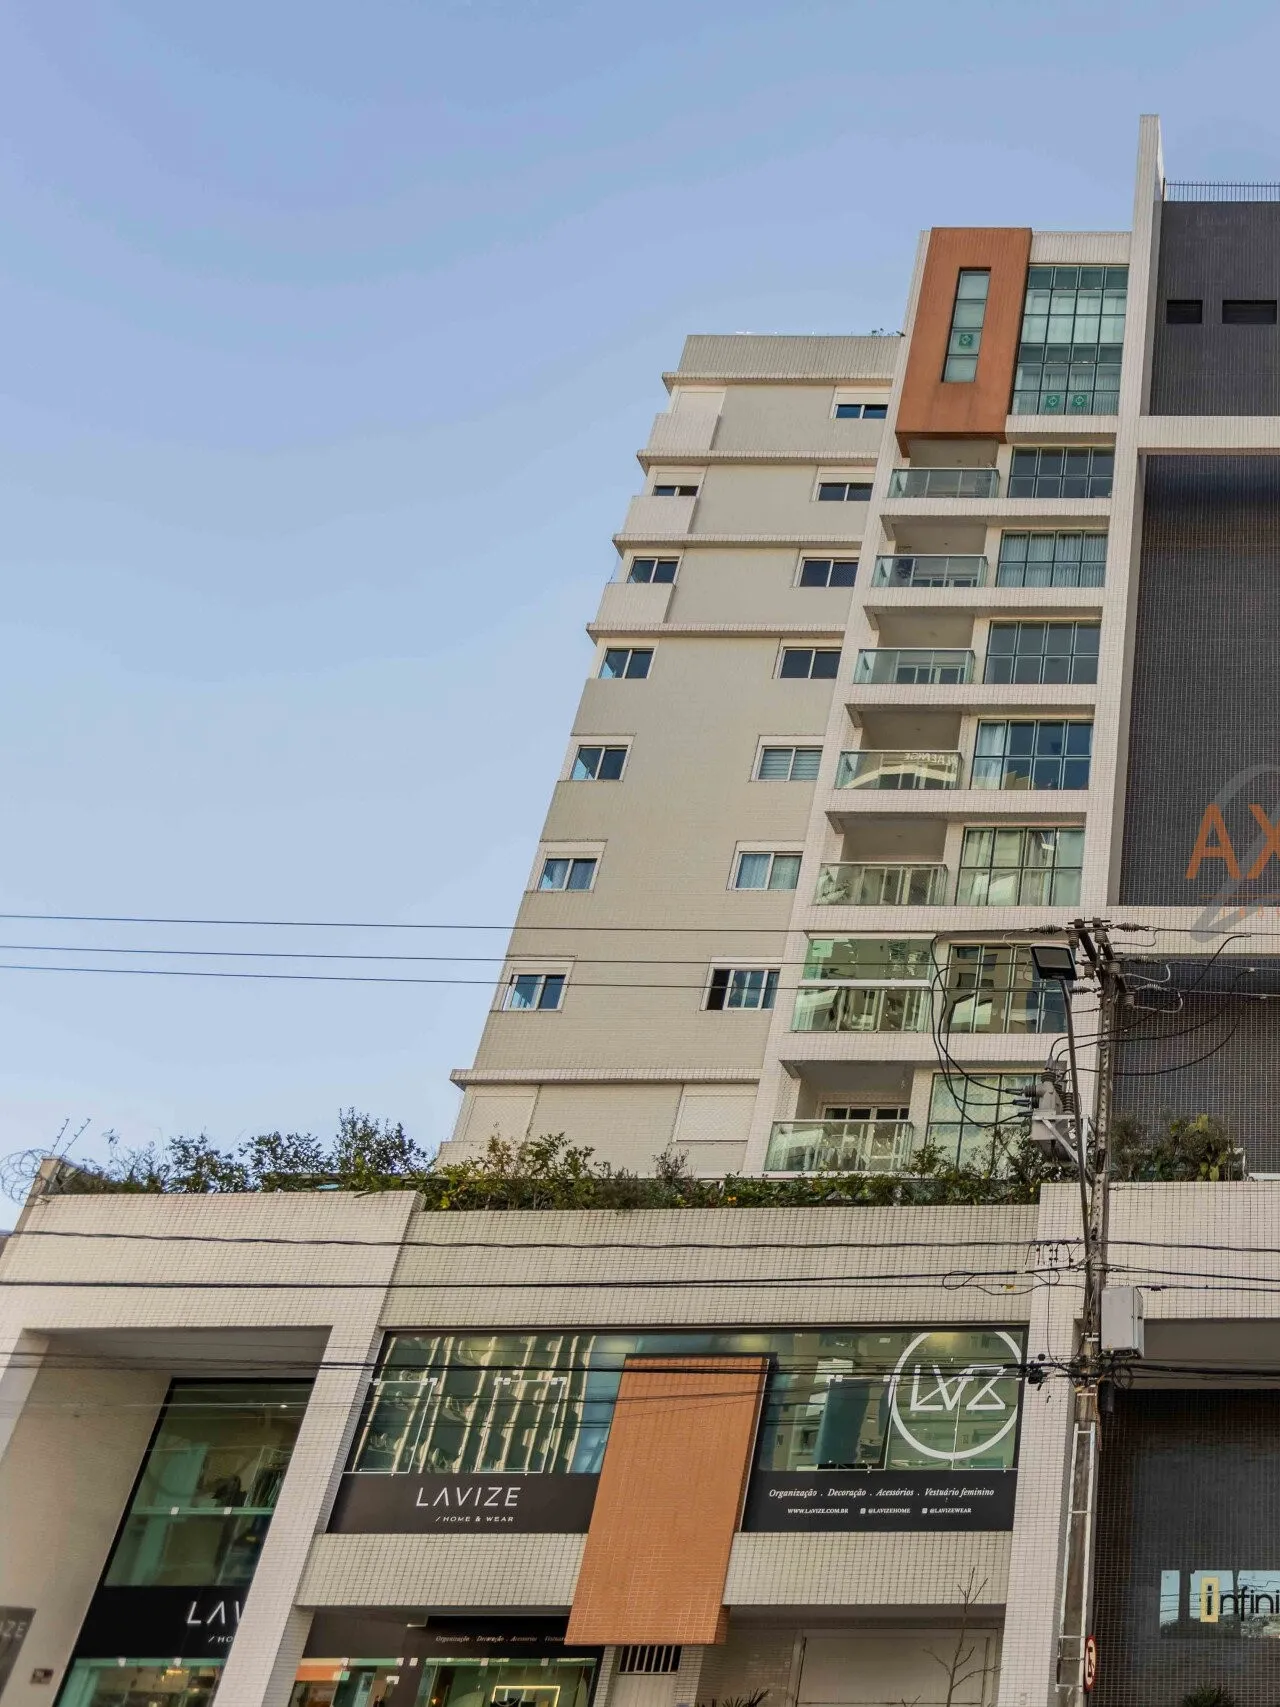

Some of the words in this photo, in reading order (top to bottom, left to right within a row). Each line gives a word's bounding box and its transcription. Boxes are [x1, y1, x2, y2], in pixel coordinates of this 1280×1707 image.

[415, 1487, 521, 1507] LAVIZE
[769, 1488, 818, 1499] Organização
[827, 1488, 867, 1498] Decoração
[876, 1488, 914, 1497] Acessórios
[924, 1487, 959, 1496] Vestuário
[958, 1487, 995, 1498] feminino
